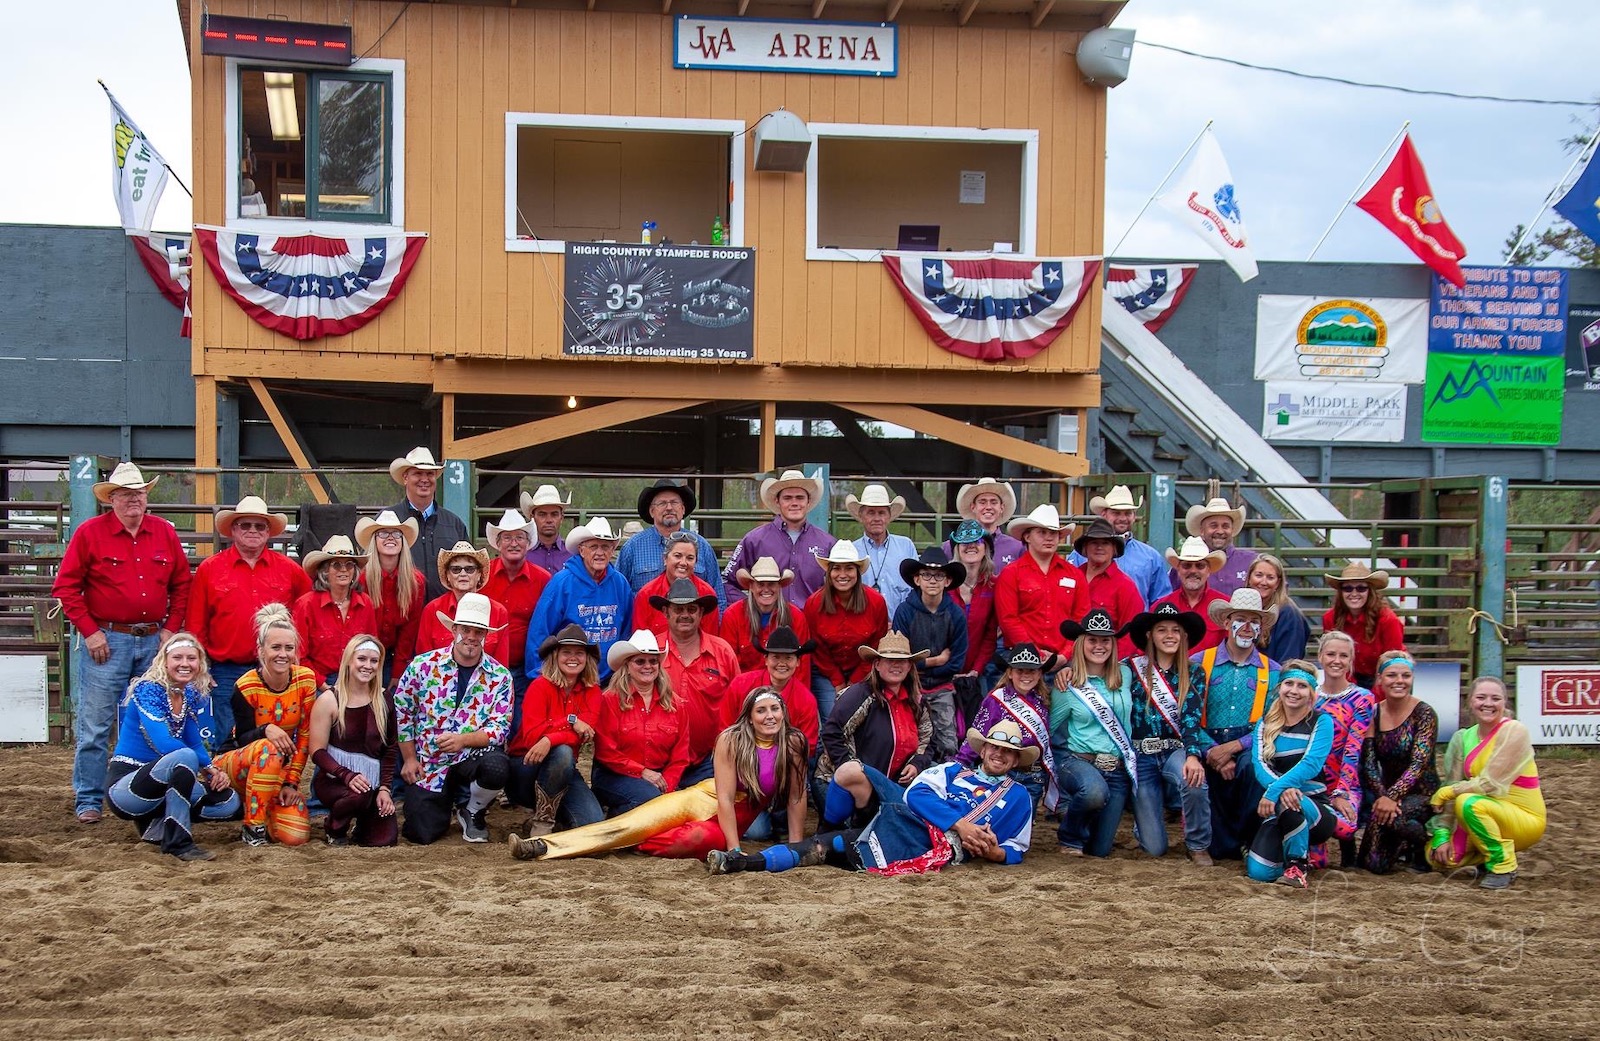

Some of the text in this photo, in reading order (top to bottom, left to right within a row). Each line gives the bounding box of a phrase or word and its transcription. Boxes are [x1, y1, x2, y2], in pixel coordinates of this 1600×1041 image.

[767, 32, 881, 61] ARENA
[132, 167, 148, 202] eat
[572, 246, 748, 260] HIGH COUNTRY STAMPEDE RODEO
[1513, 269, 1530, 282] TO
[1534, 270, 1560, 284] OUR
[1512, 286, 1538, 299] AND
[1543, 287, 1560, 300] TO
[1439, 300, 1482, 313] THOSE
[1486, 302, 1542, 315] SERVING
[1545, 302, 1558, 316] IN
[1432, 316, 1563, 332] OUR ARMED FORCES
[1453, 333, 1542, 350] THANK YOU!
[635, 346, 699, 358] Celebrating
[701, 348, 714, 357] 35
[716, 348, 748, 358] Years
[1302, 395, 1401, 409] MIDDLE PARK
[1302, 408, 1352, 416] MEDICAL
[76, 456, 93, 480] 2
[449, 461, 464, 484] 3
[1155, 474, 1169, 497] 5
[1488, 476, 1503, 499] 6
[1085, 691, 1108, 722] Country
[1020, 708, 1043, 737] Country
